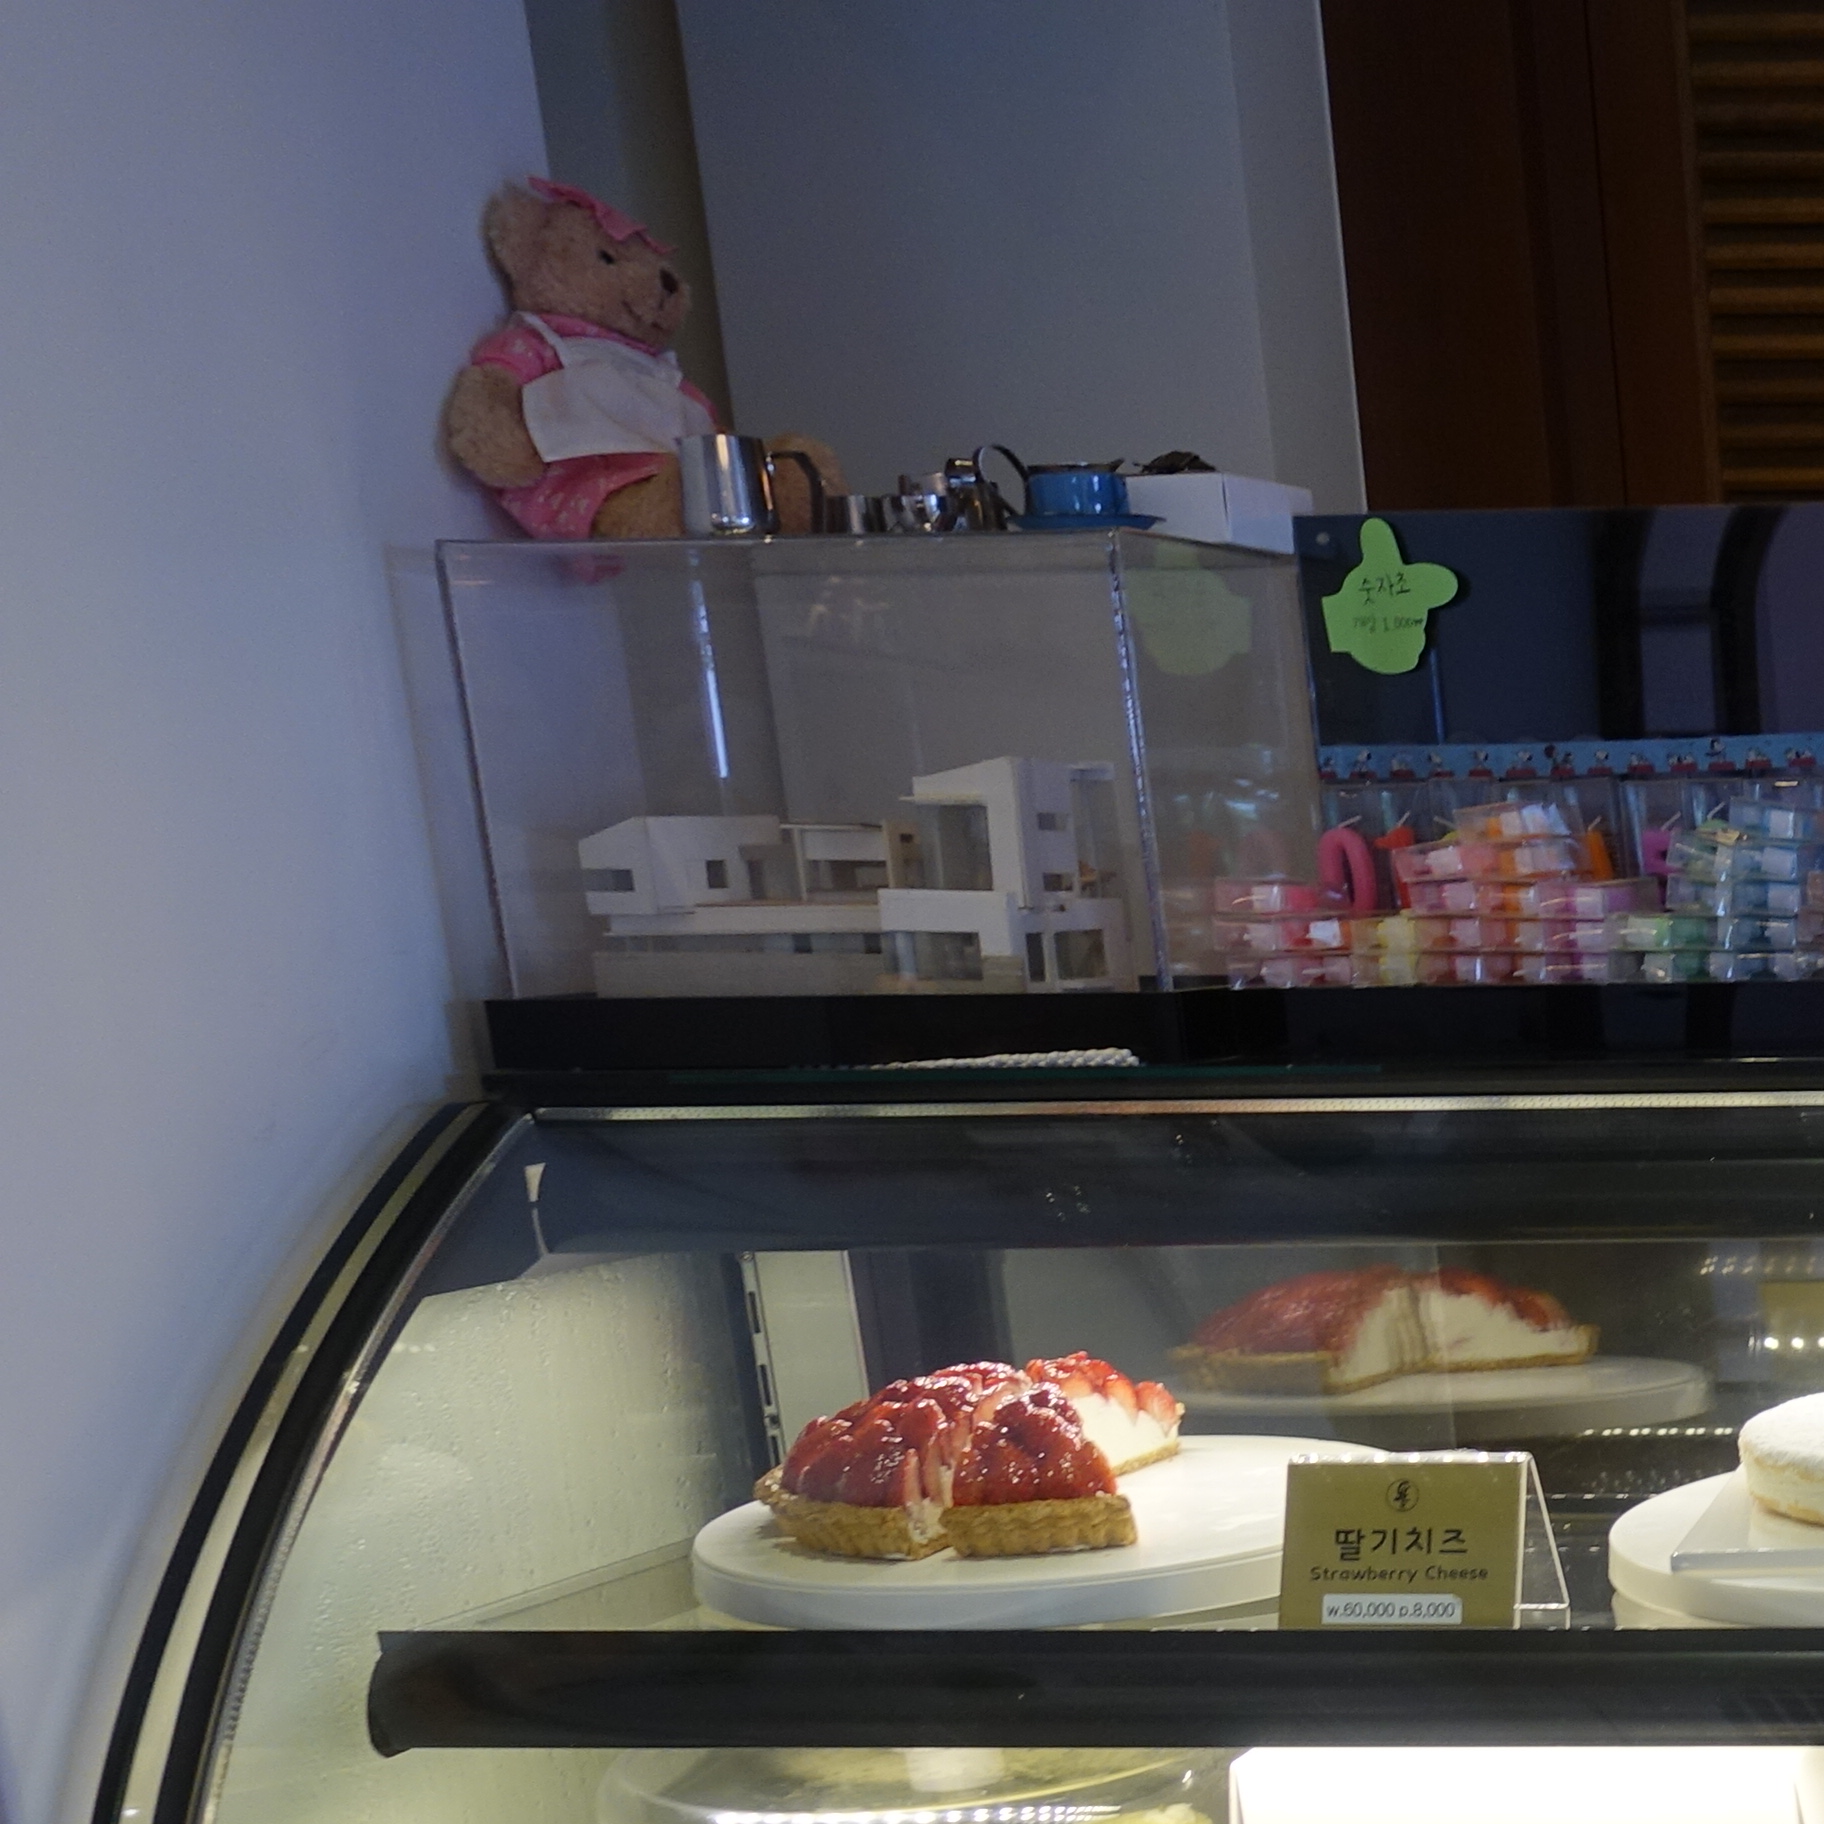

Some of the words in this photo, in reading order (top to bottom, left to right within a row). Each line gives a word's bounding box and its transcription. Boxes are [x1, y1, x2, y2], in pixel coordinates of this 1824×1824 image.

[1335, 1527, 1469, 1562] 딸기치즈
[1310, 1566, 1418, 1584] Strawberry
[1425, 1566, 1488, 1580] Cheese
